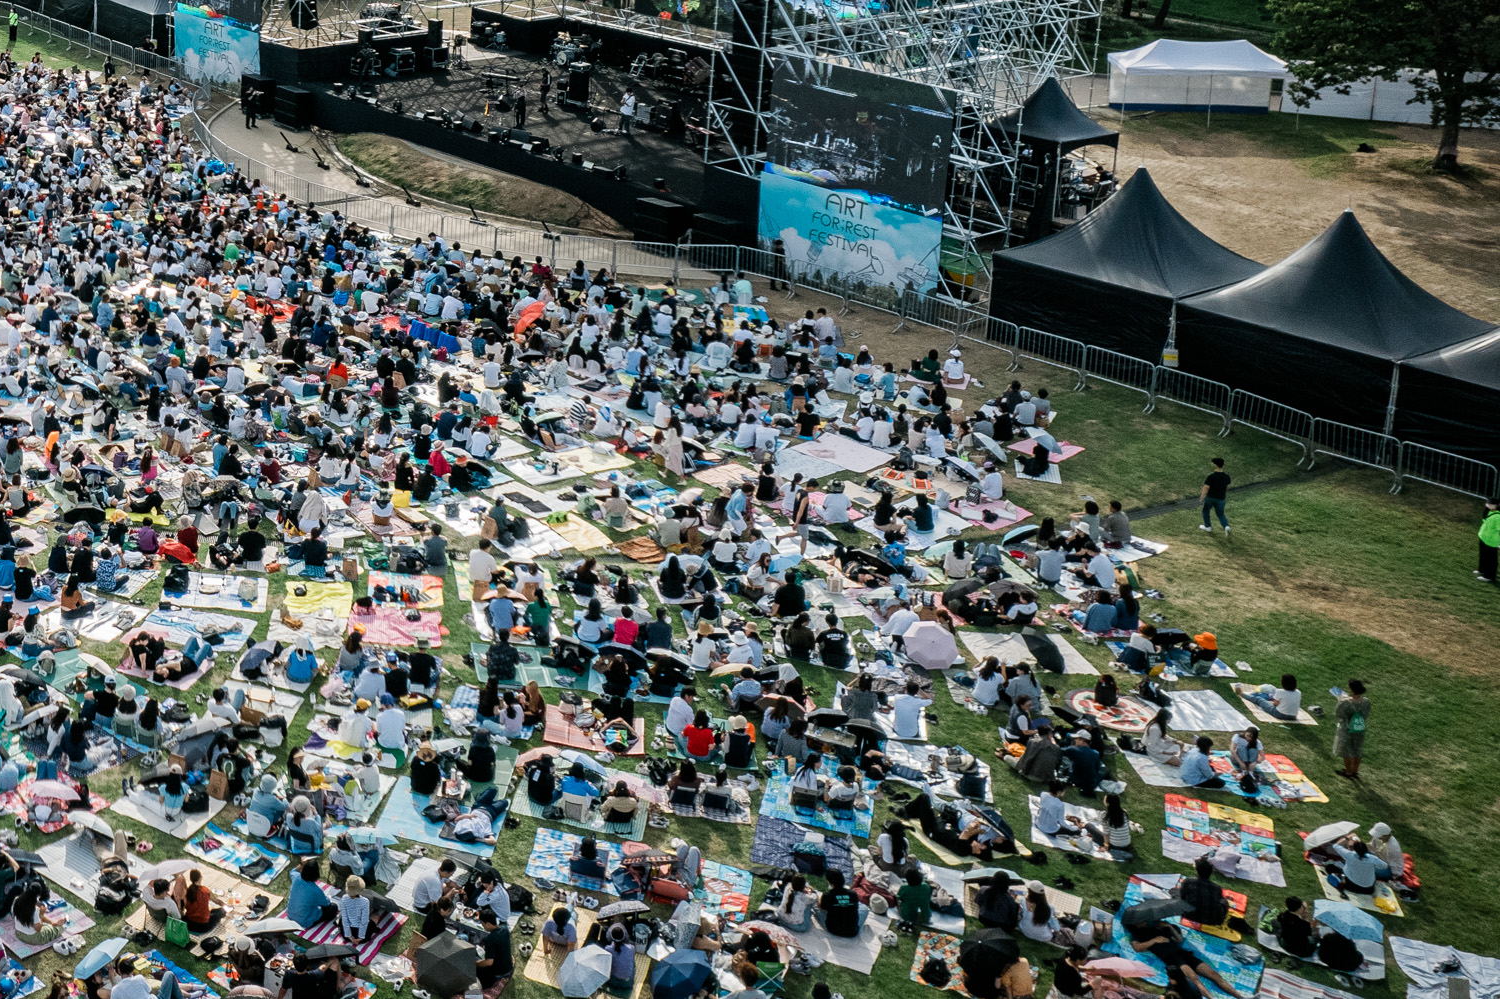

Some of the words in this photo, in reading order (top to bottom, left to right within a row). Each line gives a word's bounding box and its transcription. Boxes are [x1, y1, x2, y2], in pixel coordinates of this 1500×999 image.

[203, 21, 225, 38] ART
[197, 47, 231, 62] FESTIVAL
[825, 193, 869, 220] ART
[811, 211, 879, 240] FOR;REST
[808, 228, 877, 259] FESTIVAL
